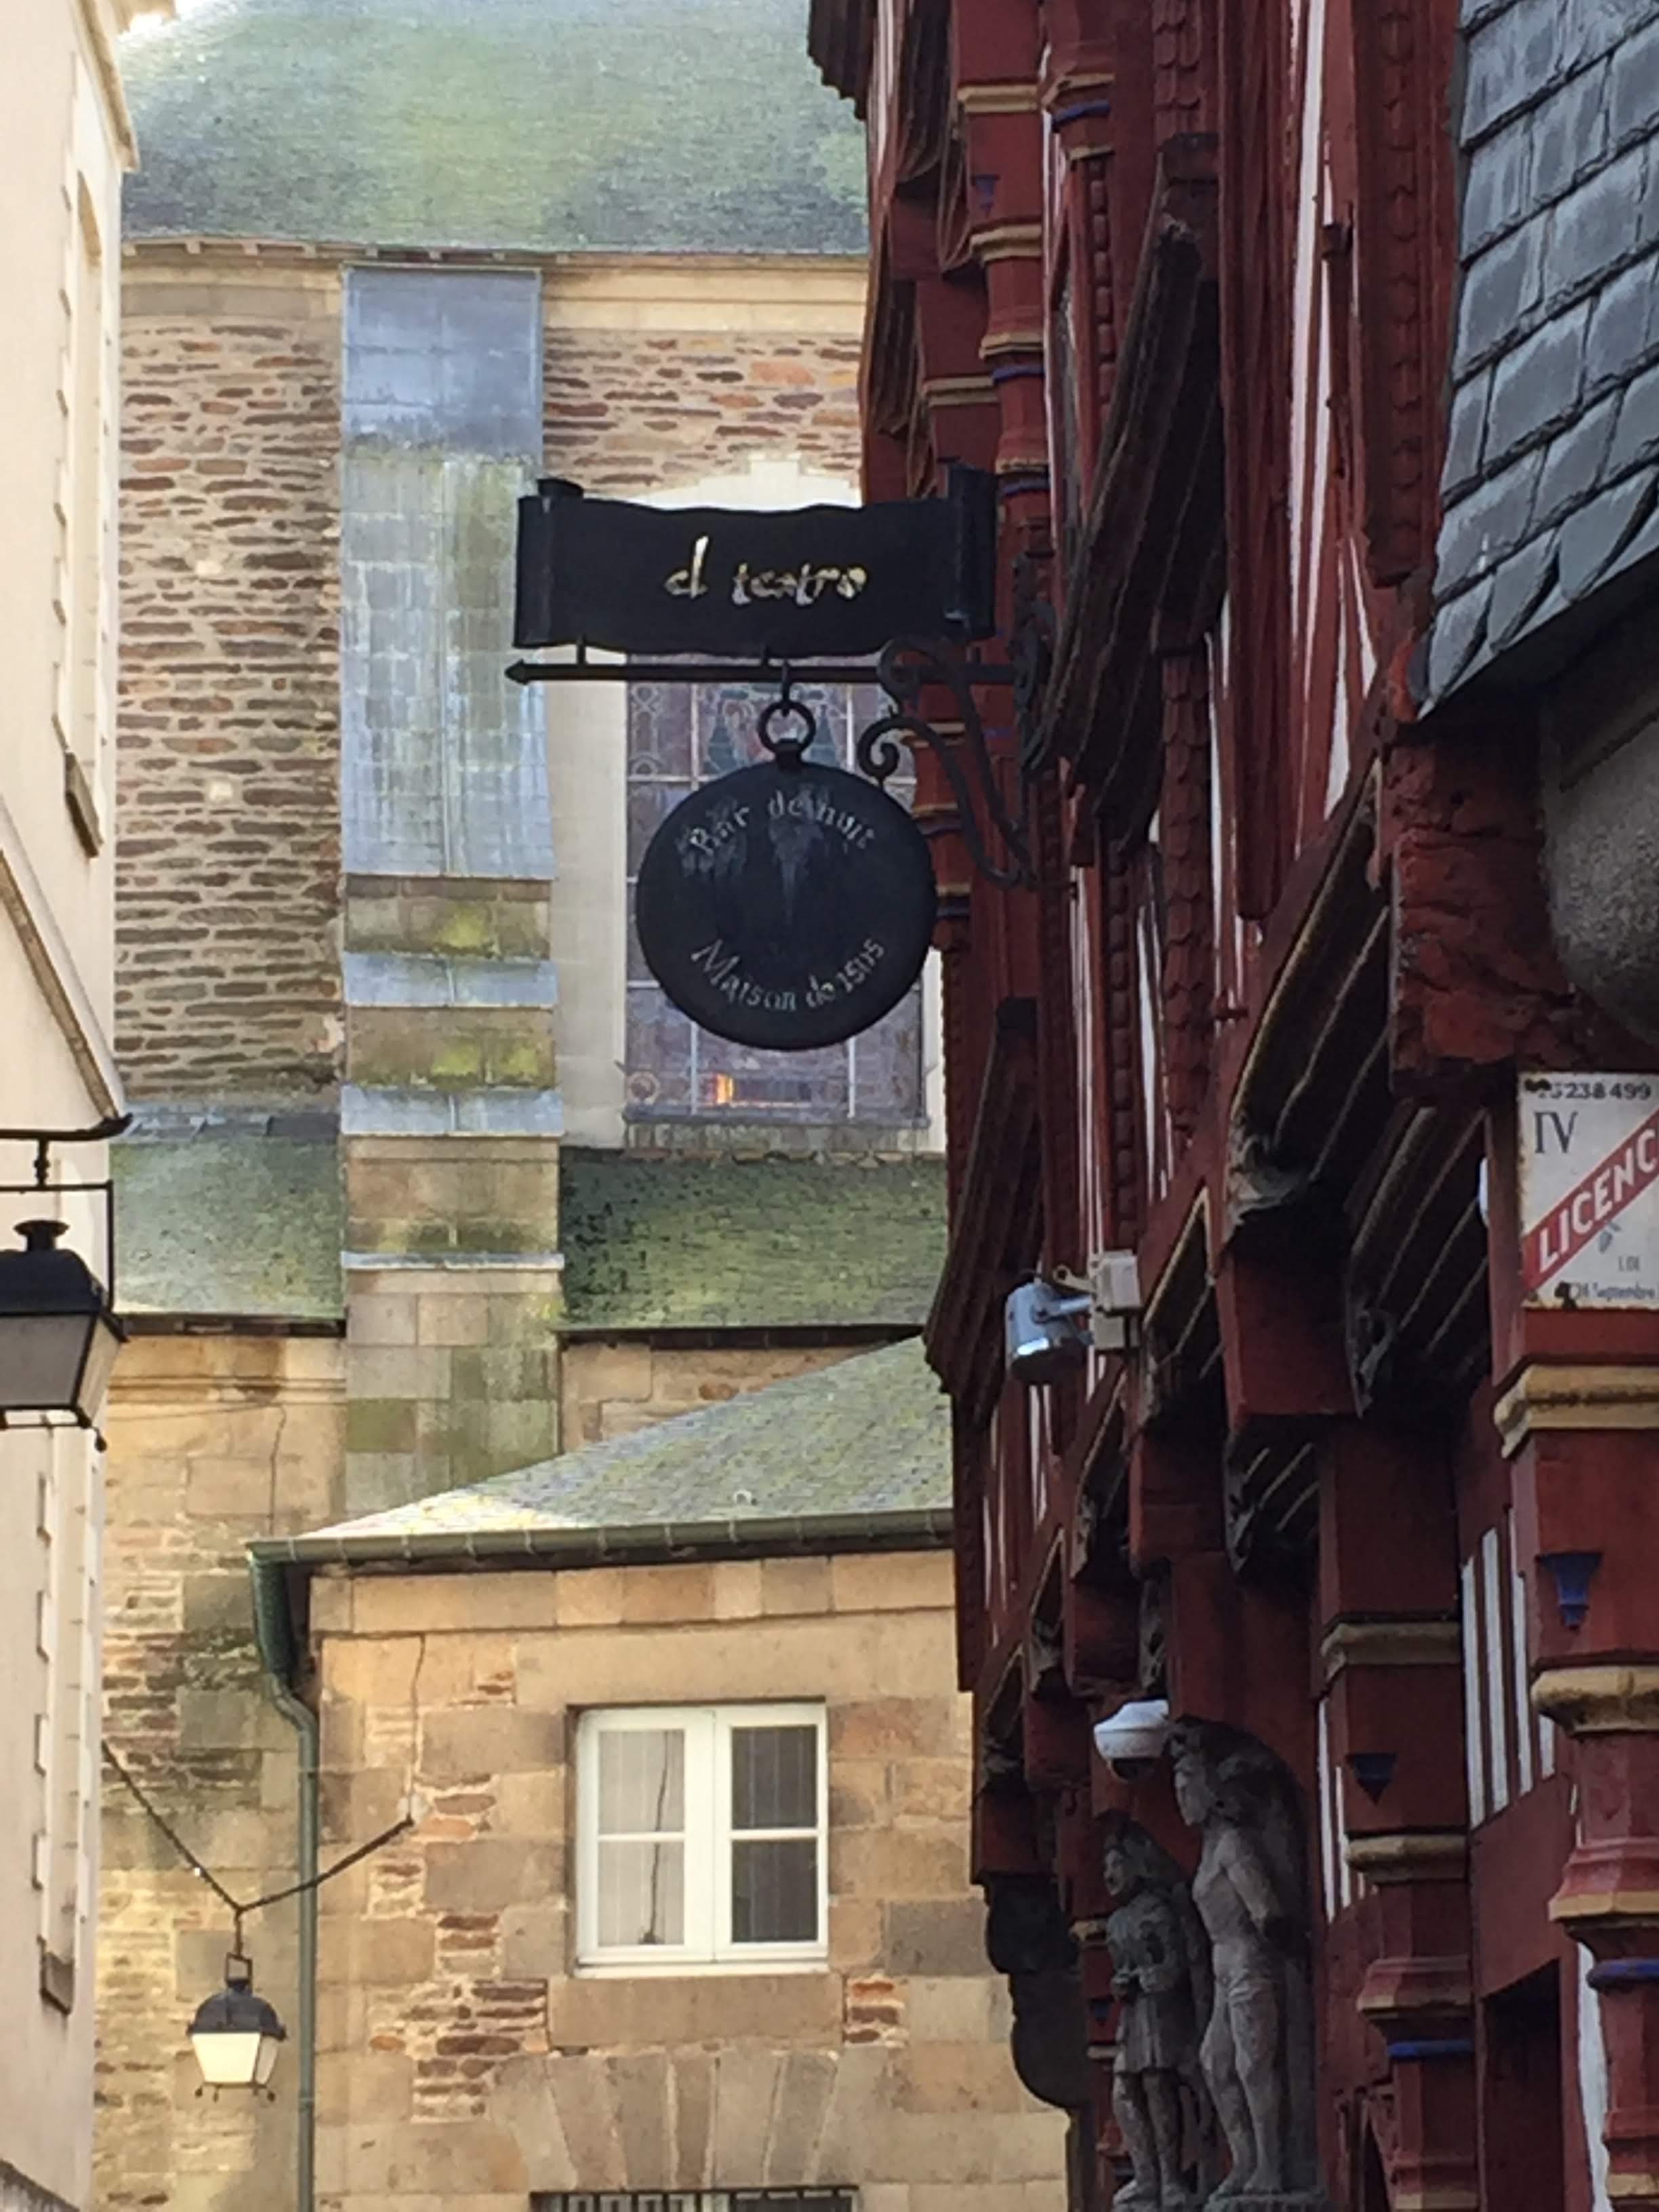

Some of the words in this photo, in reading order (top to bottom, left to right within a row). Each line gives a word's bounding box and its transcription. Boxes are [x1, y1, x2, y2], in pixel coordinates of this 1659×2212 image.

[689, 806, 750, 857] Bar
[691, 938, 798, 1012] Maison
[805, 974, 836, 1008] de
[1534, 1111, 1578, 1154] IV
